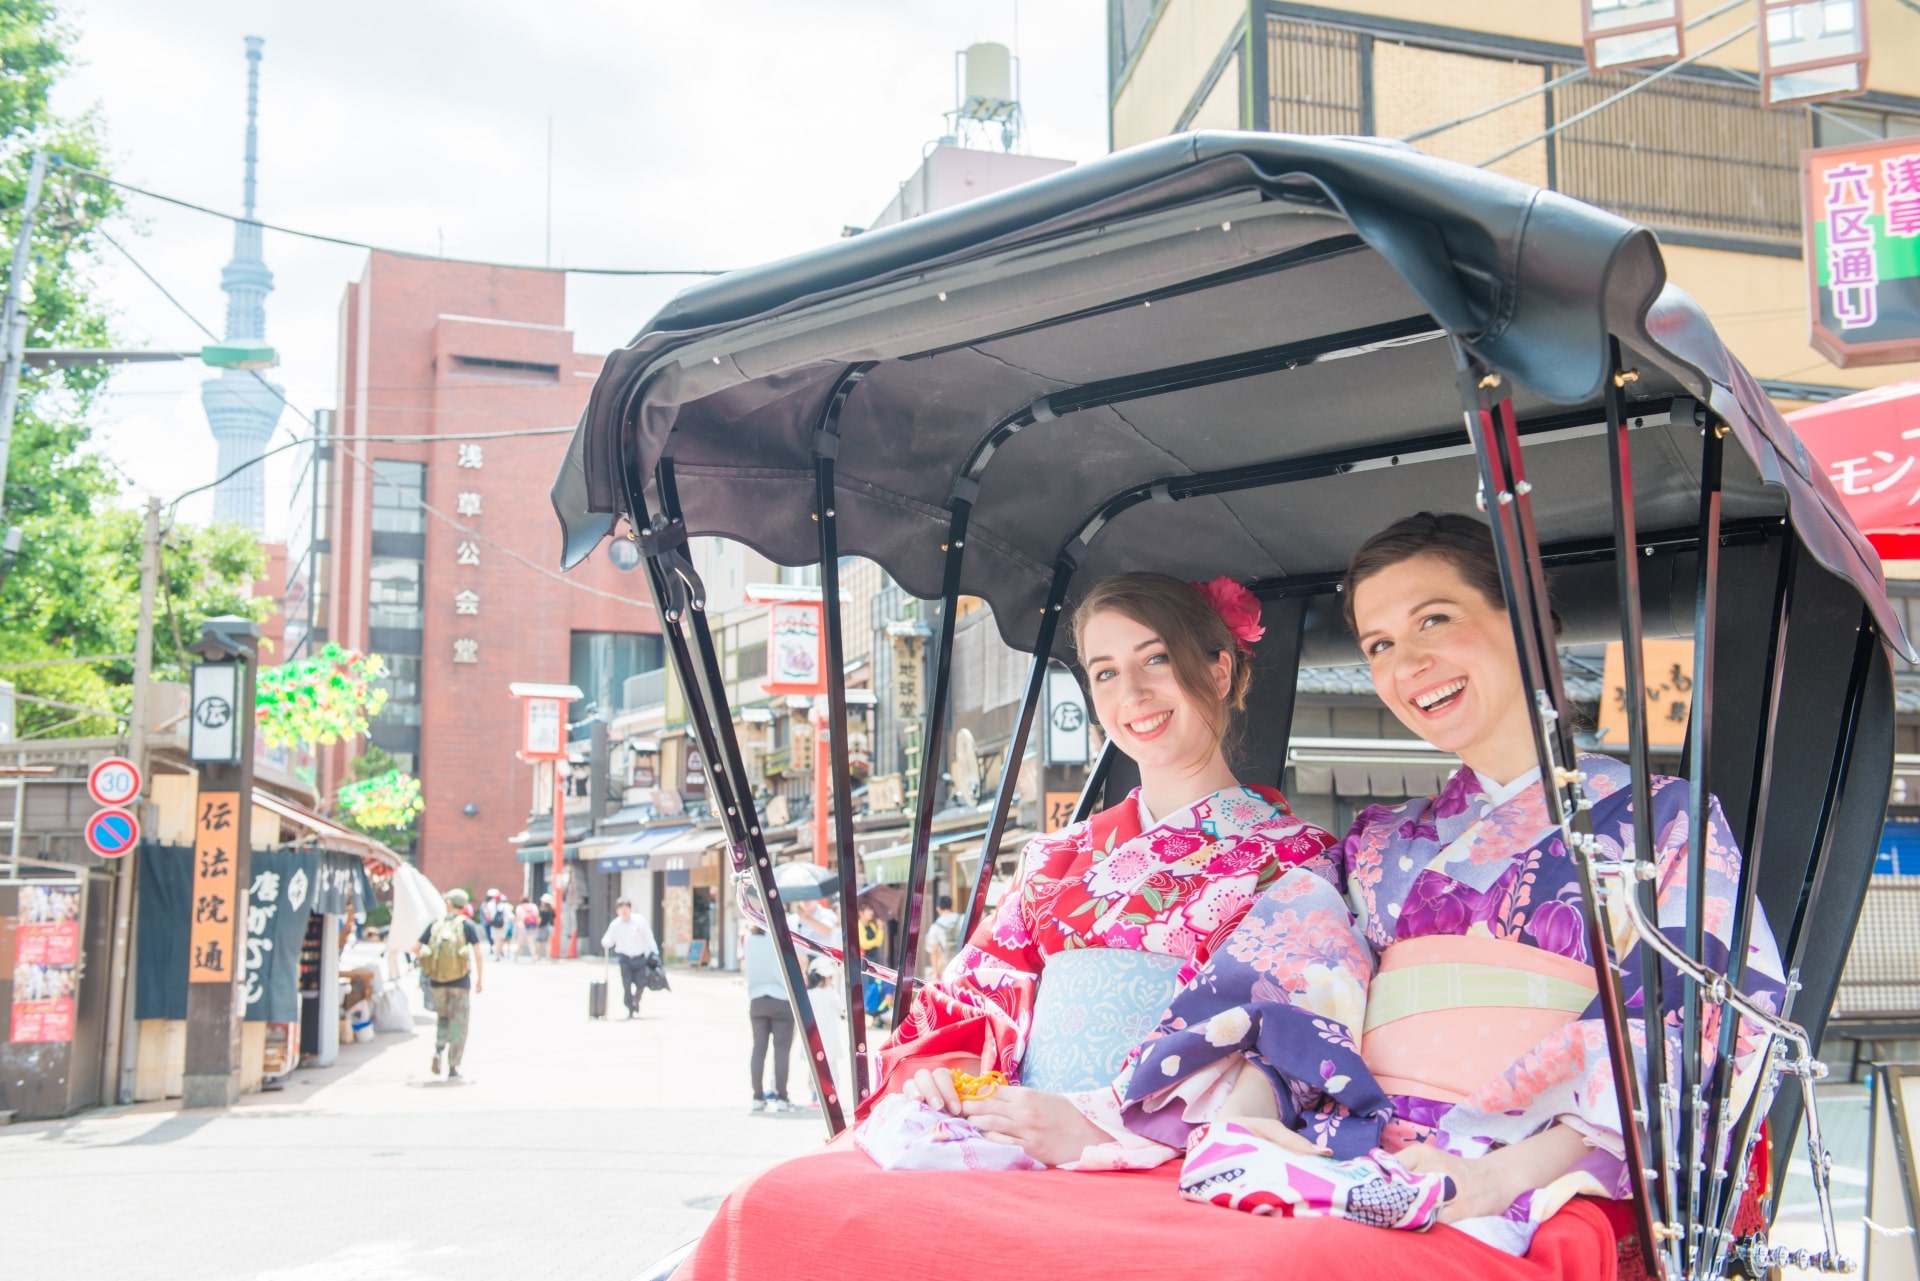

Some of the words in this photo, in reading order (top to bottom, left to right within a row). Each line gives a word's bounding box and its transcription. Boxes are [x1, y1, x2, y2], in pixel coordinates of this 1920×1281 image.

[1881, 157, 1920, 236] 浅草
[1825, 164, 1876, 327] 六区通り
[1829, 427, 1920, 507] モン
[453, 443, 483, 664] 浅草公会堂
[196, 696, 231, 728] 伝
[898, 661, 917, 720] 地球堂
[1052, 702, 1084, 732] 伝
[101, 772, 130, 793] 30
[194, 802, 232, 972] 伝法院通
